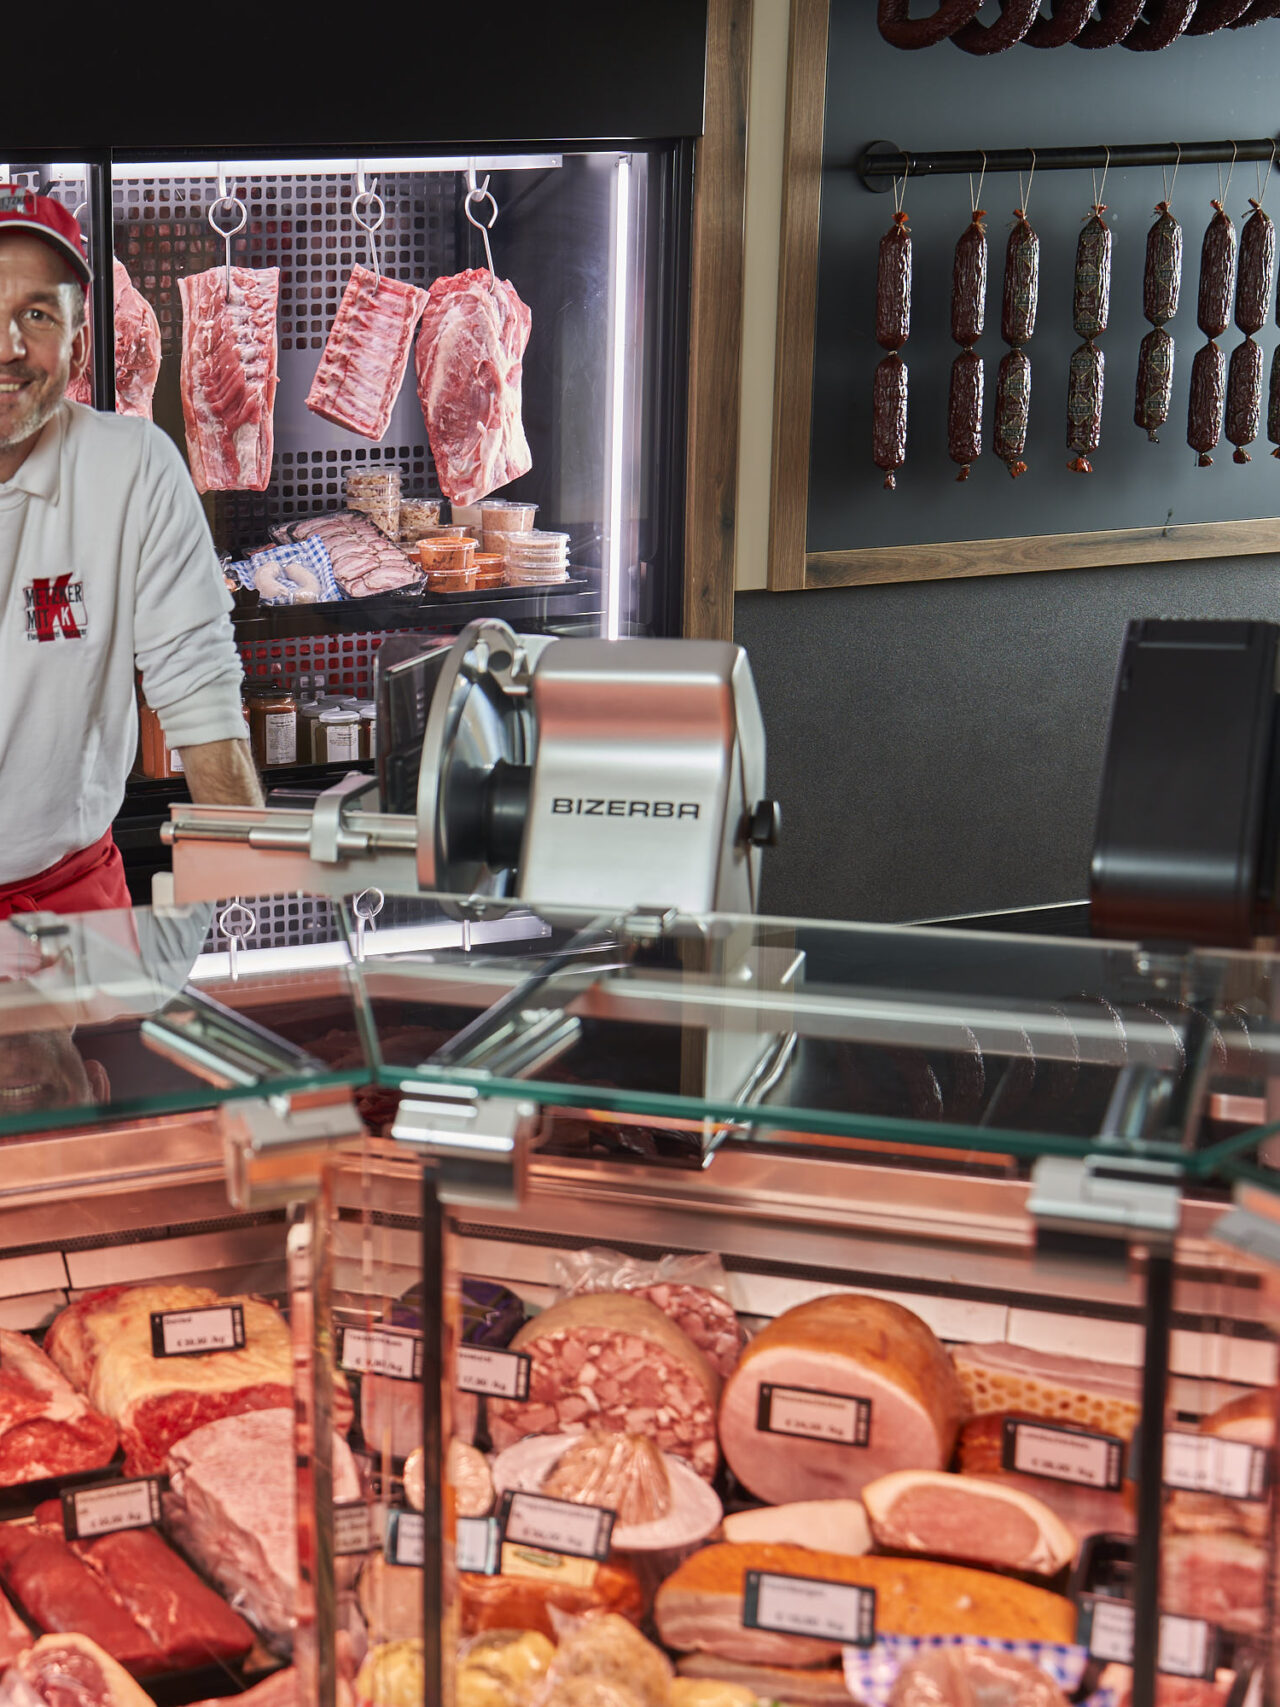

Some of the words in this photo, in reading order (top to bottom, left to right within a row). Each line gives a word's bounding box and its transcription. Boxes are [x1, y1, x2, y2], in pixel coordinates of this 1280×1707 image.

[26, 583, 82, 608] METZKER
[26, 609, 49, 629] MIT
[552, 798, 700, 819] BIZERBA
